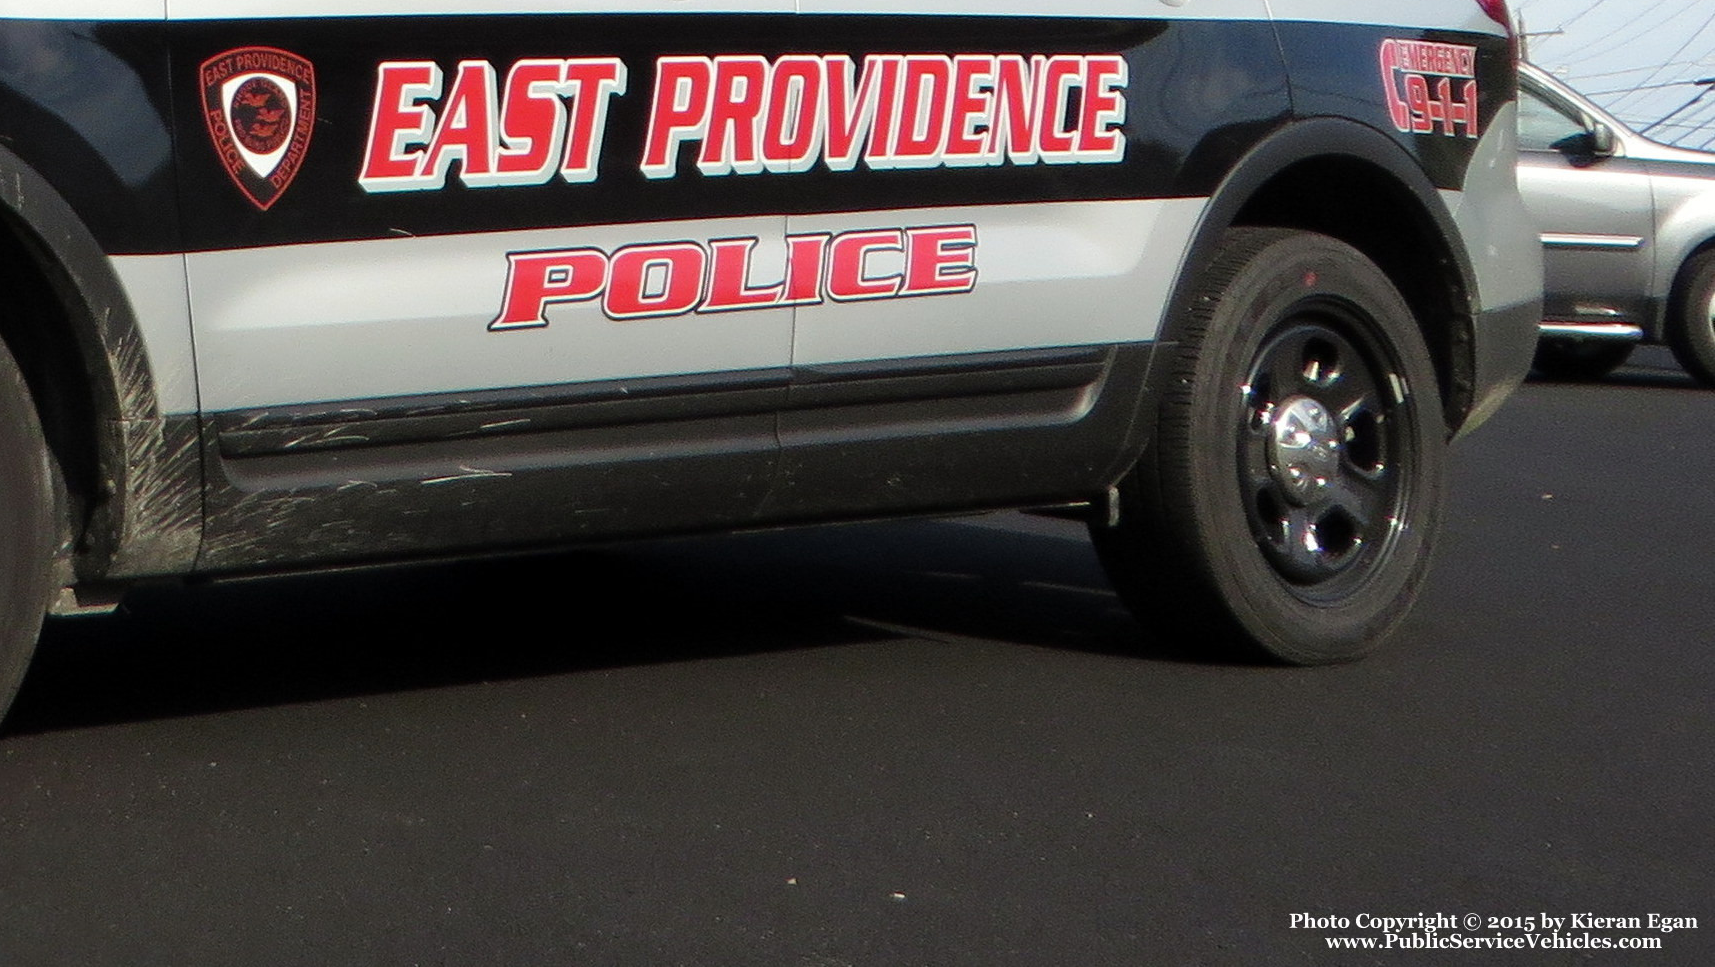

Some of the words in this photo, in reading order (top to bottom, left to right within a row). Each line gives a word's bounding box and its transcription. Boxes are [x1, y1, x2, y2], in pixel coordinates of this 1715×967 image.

[205, 62, 233, 86] EAST
[236, 53, 312, 85] PROVIDENCE
[210, 109, 246, 175] POLICE
[270, 88, 312, 189] DEPARTMENT
[358, 57, 628, 193] EAST
[639, 54, 1129, 177] PROVIDENCE
[487, 224, 978, 332] POLICE
